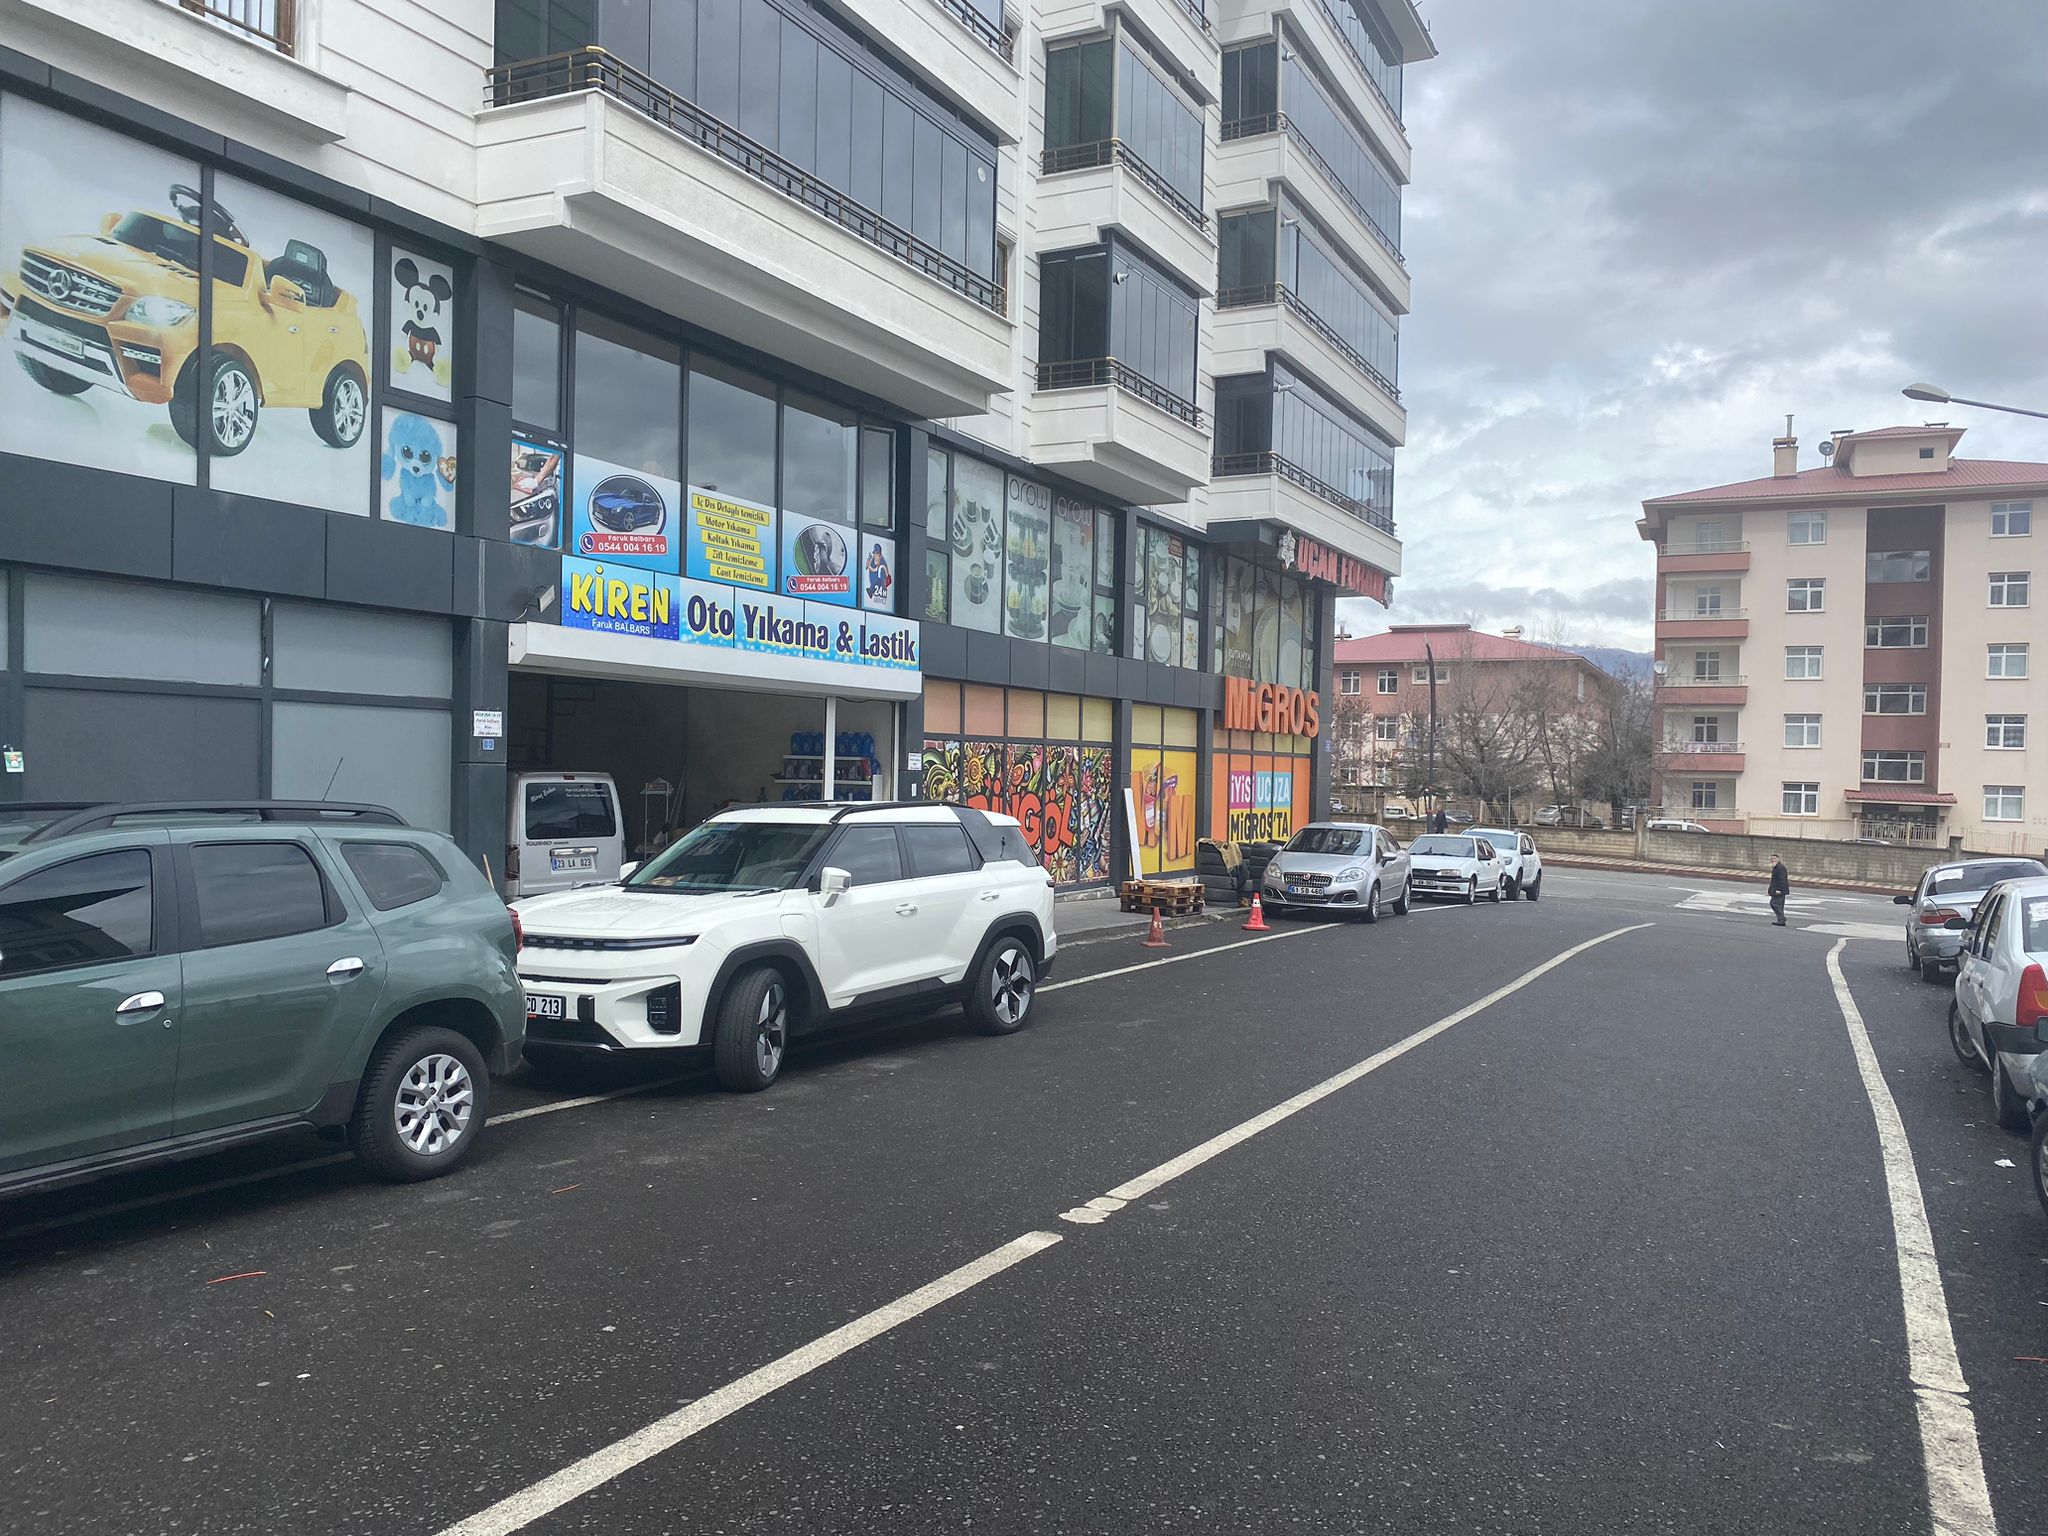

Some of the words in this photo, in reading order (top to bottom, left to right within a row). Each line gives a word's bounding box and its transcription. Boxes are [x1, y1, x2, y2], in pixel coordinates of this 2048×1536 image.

[1009, 478, 1048, 511] arow
[1057, 496, 1092, 526] arow
[705, 516, 725, 529] Motor
[726, 520, 751, 535] Yıkama
[598, 542, 621, 552] 0544
[623, 543, 640, 552] 004
[642, 543, 653, 552] 16
[655, 544, 666, 553] 19
[629, 535, 655, 543] Balbars
[707, 532, 729, 546] Koltuk
[731, 537, 755, 551] Yıkama
[712, 549, 723, 560] Zift
[725, 552, 758, 568] Temizleme
[733, 568, 764, 584] Temizleme
[571, 565, 670, 625] KİREN
[800, 583, 816, 591] 0544
[817, 583, 830, 591] 004
[840, 583, 848, 591] 19
[592, 618, 613, 629] Faruk
[614, 621, 651, 635] BALBARS
[687, 594, 734, 636] Oto
[742, 603, 829, 650] Yıkama
[836, 620, 854, 653] &
[859, 624, 916, 662] Lastik
[1257, 776, 1290, 803] UCUZA
[558, 859, 565, 868] 23
[567, 859, 576, 867] LA
[1292, 886, 1300, 894] 61
[1301, 886, 1310, 894] SB
[541, 998, 560, 1014] 213
